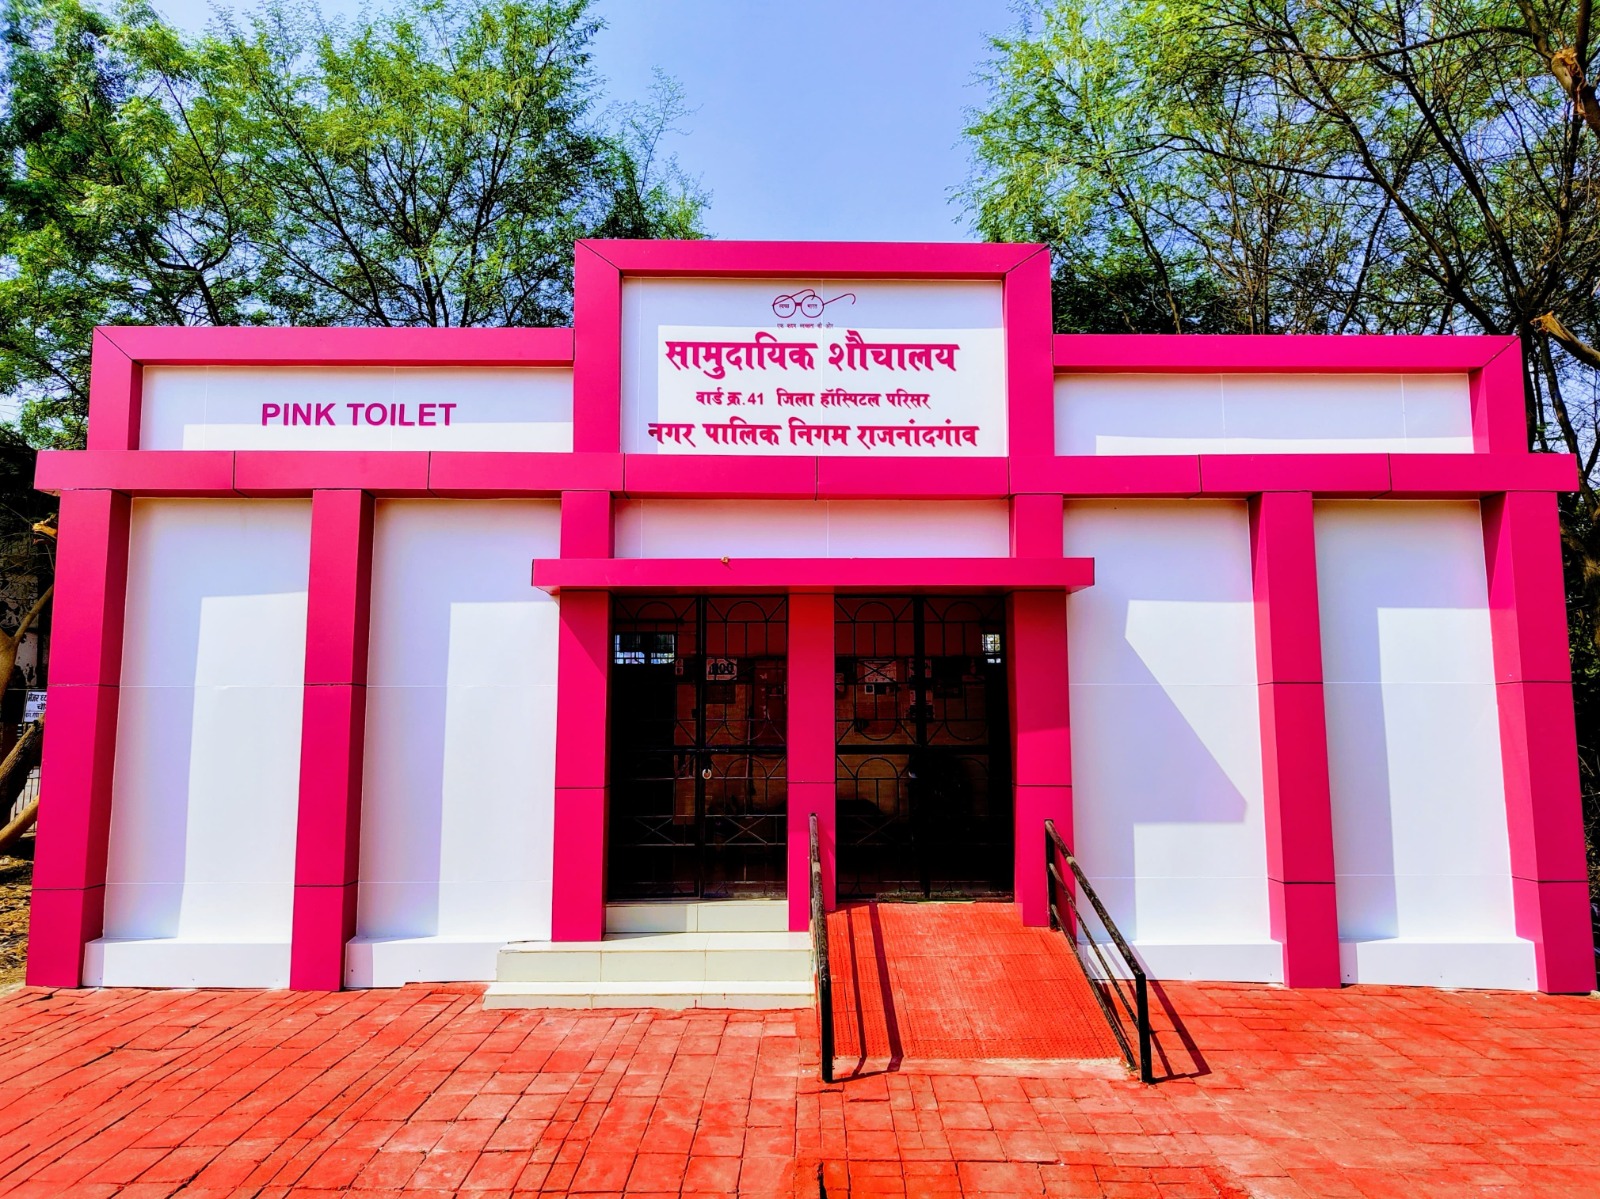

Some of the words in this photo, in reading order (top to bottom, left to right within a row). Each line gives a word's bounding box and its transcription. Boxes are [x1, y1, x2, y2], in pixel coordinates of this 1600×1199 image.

[665, 332, 818, 379] सामुदायिक
[828, 330, 960, 371] शौचालय
[696, 387, 724, 406] वार्ड
[776, 388, 815, 407] जिला
[820, 388, 881, 408] हॉस्पिटल
[886, 389, 931, 409] परिसर
[261, 403, 336, 426] PINK
[346, 403, 457, 426] TOILET
[648, 422, 696, 447] नगर
[702, 416, 782, 446] पालिक
[788, 417, 852, 446] निगम
[857, 418, 980, 450] राजनांदगांव
